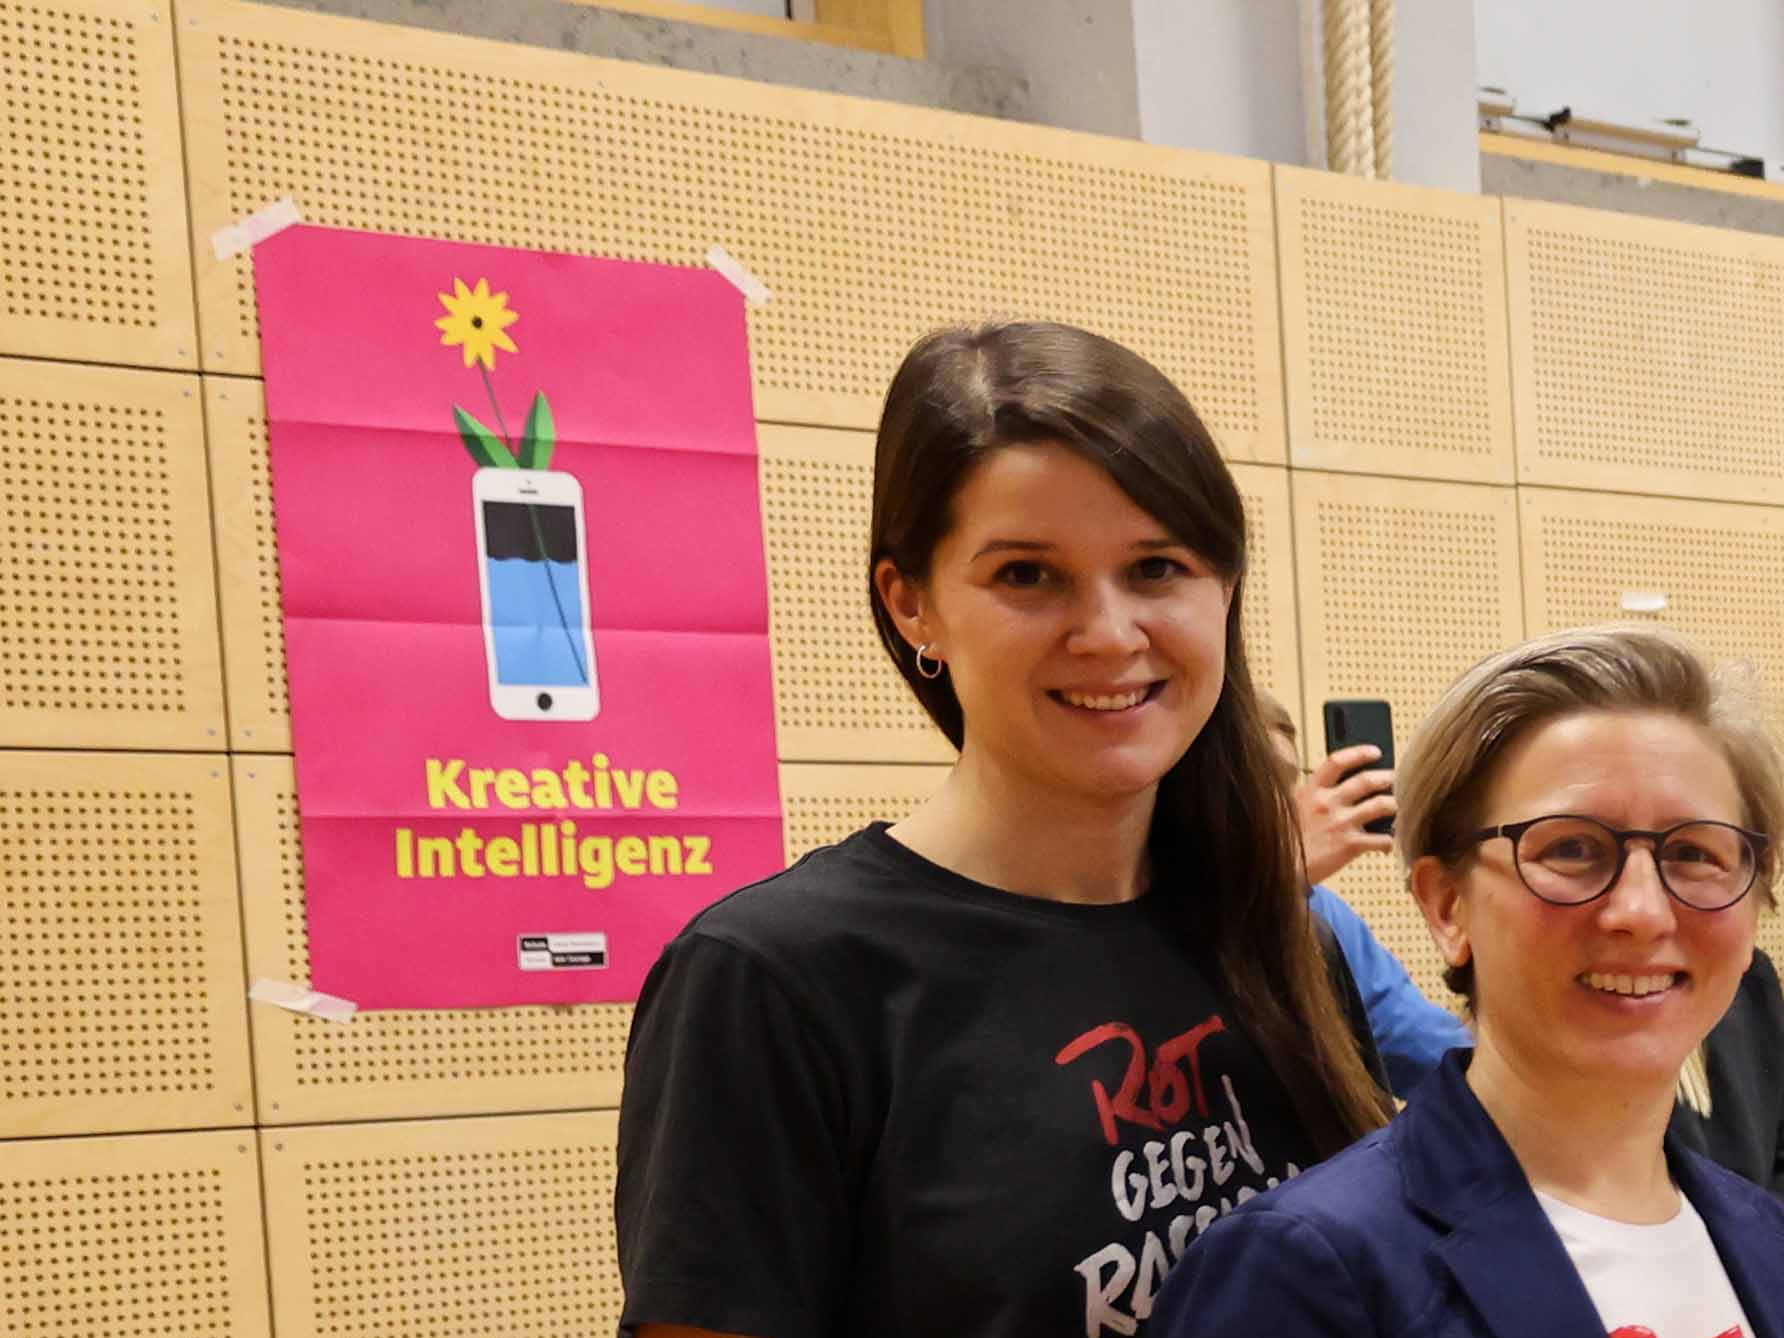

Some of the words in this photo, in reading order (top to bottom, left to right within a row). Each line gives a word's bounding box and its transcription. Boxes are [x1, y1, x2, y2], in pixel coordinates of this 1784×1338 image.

[425, 752, 679, 809] Kreative
[396, 820, 714, 889] Intelligenz
[1055, 1014, 1226, 1146] ROT
[1111, 1073, 1265, 1222] GEGEN
